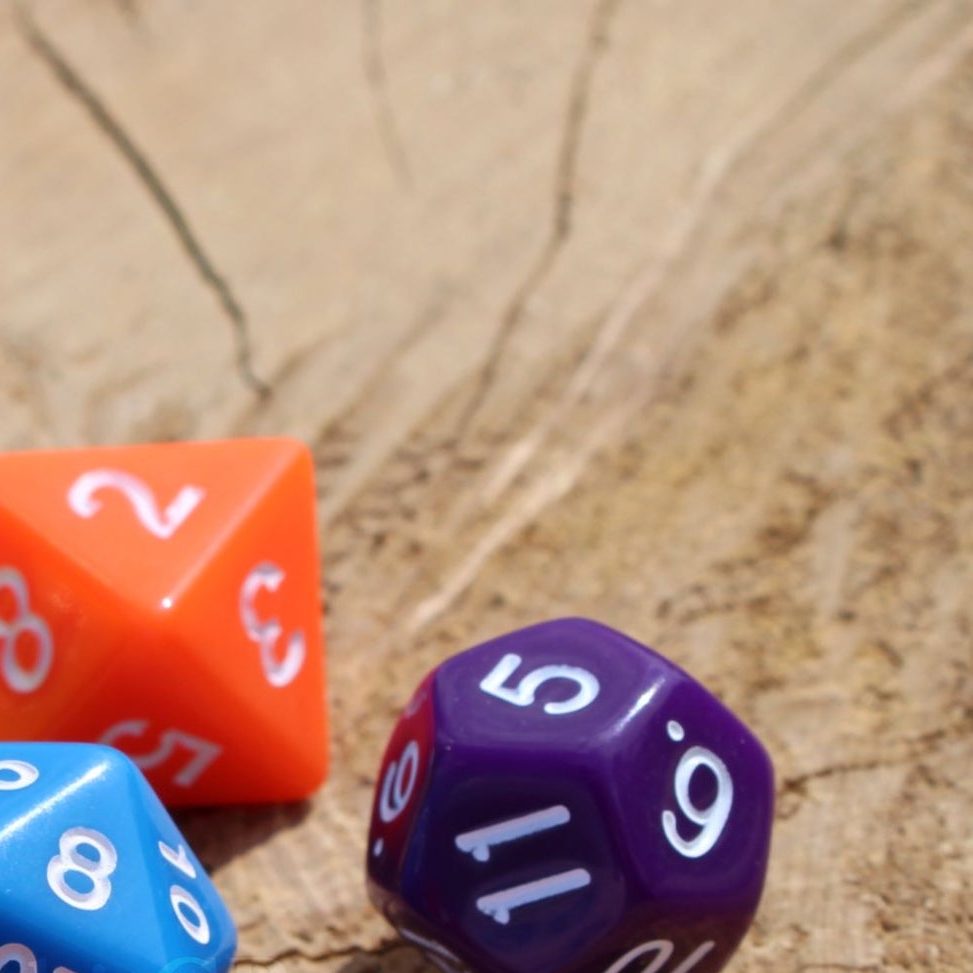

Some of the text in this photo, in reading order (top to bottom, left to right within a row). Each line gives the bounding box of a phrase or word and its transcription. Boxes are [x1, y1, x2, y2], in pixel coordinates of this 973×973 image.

[67, 468, 206, 538] 2
[239, 560, 307, 688] 3
[479, 653, 600, 715] 5
[101, 720, 221, 786] 5
[46, 826, 118, 911] 8
[159, 840, 210, 945] 10
[455, 805, 591, 925] 11
